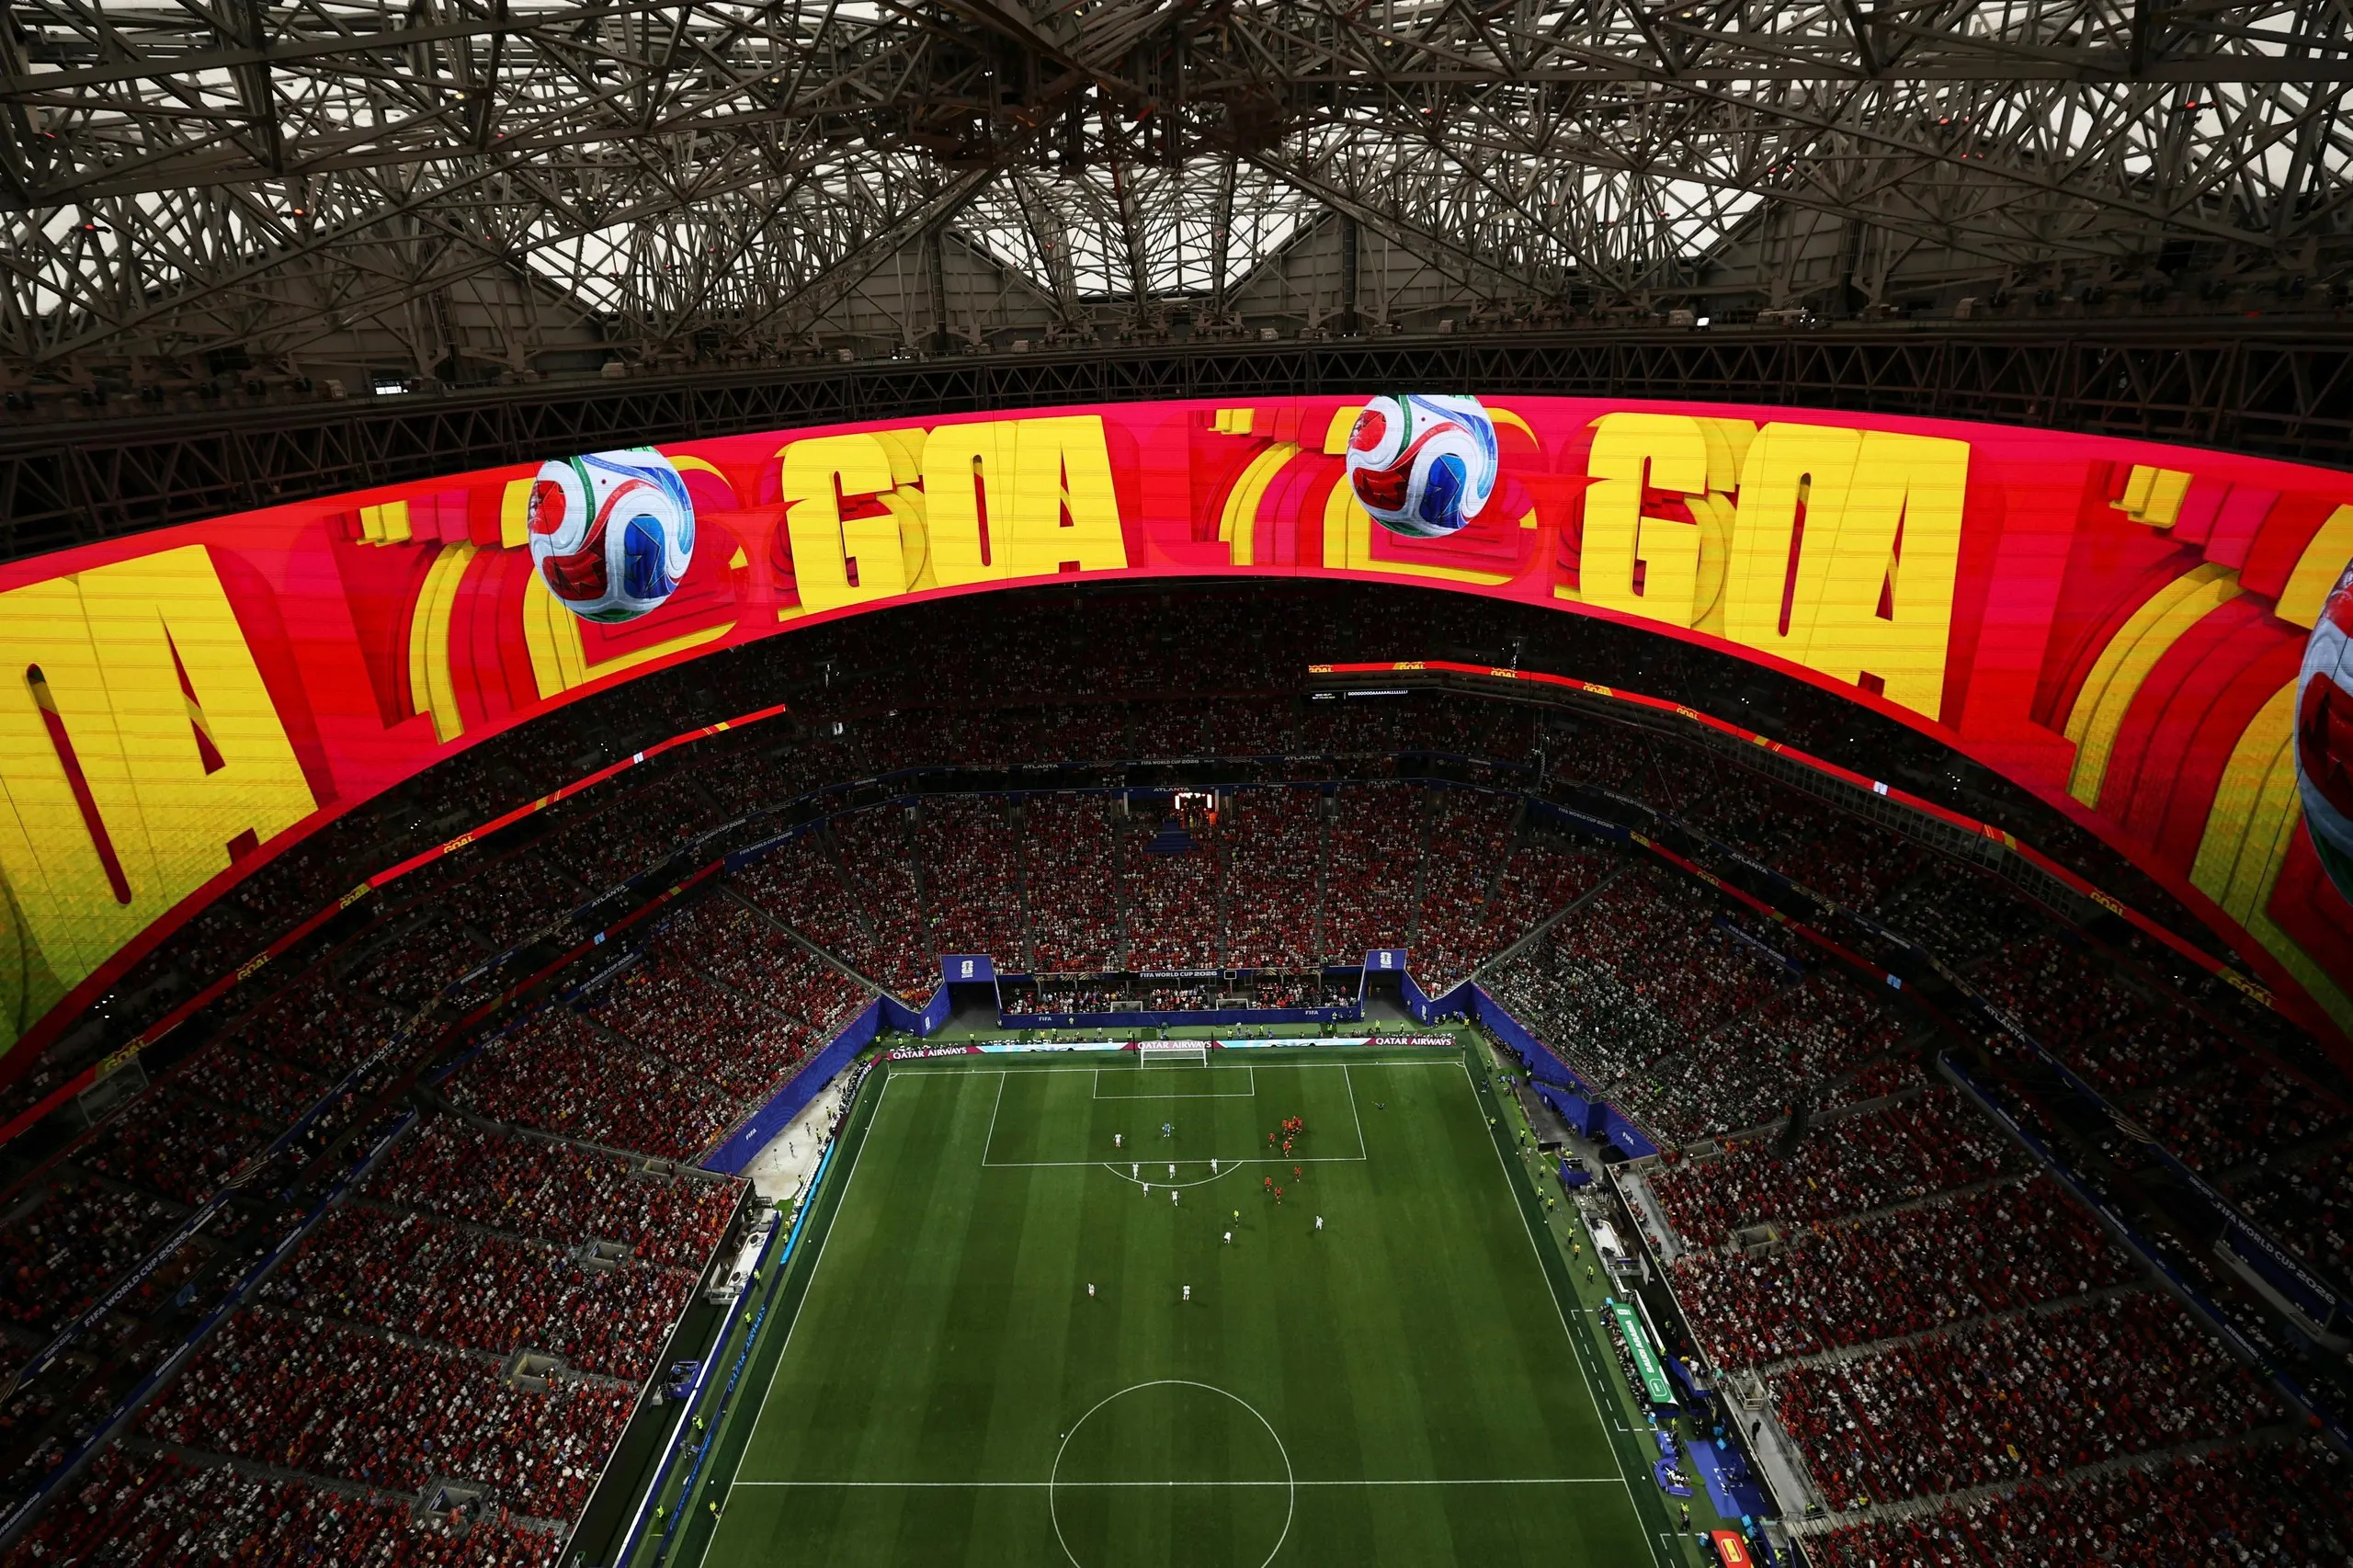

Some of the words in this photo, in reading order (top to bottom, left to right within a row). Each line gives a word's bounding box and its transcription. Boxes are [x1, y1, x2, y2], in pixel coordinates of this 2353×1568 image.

[1491, 670, 1518, 678] GOAL
[1677, 707, 1700, 721] GOAL
[444, 835, 476, 854] GOAL
[1731, 852, 1768, 875] ATLANTA
[591, 884, 626, 908] ATLANTA
[2089, 891, 2126, 919] GOAL
[237, 955, 272, 981] GOAL
[1984, 1005, 2026, 1042] ATLANTA
[893, 1050, 924, 1059] QATAR
[927, 1047, 967, 1057] AIRWAYS
[1138, 1041, 1172, 1050] QATAR
[1411, 1038, 1451, 1046] AIRWAYS
[357, 1040, 395, 1077] ATLANTA
[745, 1128, 757, 1140] FIFA
[1622, 1131, 1634, 1145] FIFA
[2215, 1200, 2238, 1221] FIFA
[2235, 1219, 2275, 1252] WORLD
[2273, 1248, 2298, 1270] CUP
[2296, 1267, 2337, 1303] 2026
[82, 1304, 107, 1327] FIFA
[104, 1274, 142, 1308] WORLD
[138, 1256, 160, 1277] CUP
[156, 1230, 189, 1260] 2026
[1625, 1320, 1643, 1349] ARABIA
[1638, 1348, 1654, 1373] SAUDI
